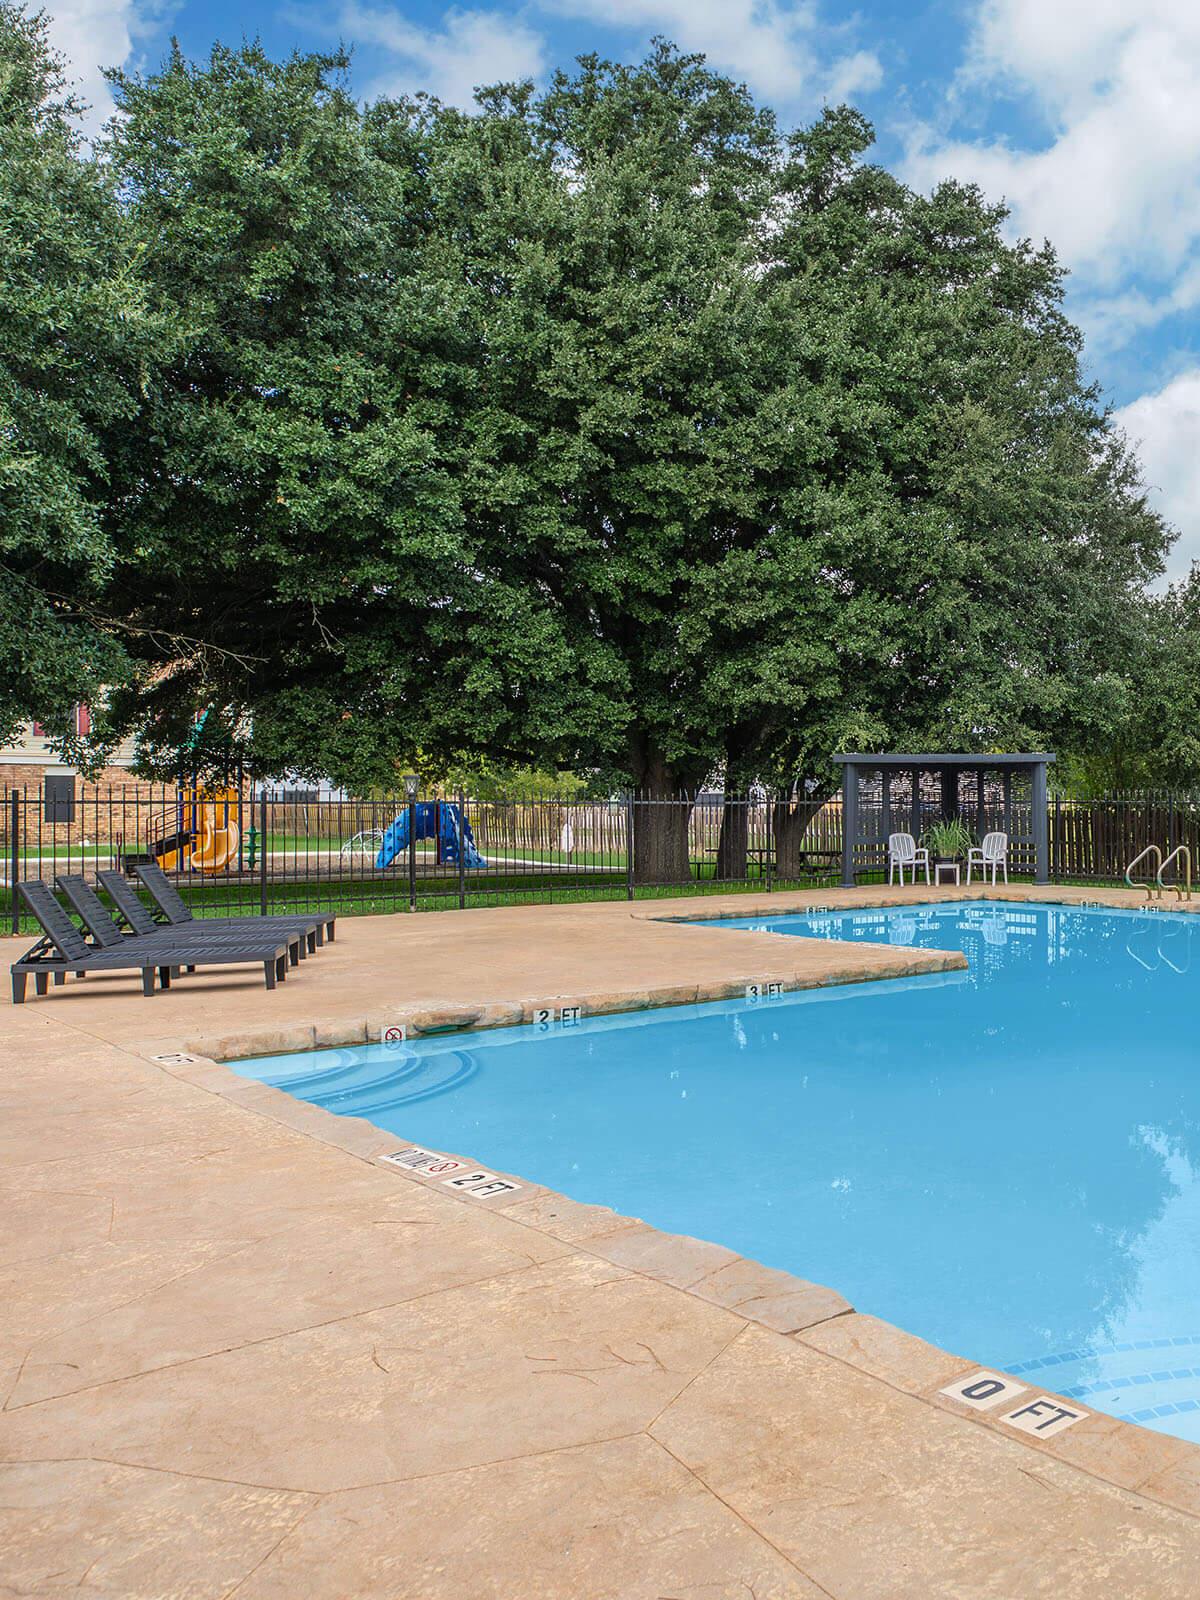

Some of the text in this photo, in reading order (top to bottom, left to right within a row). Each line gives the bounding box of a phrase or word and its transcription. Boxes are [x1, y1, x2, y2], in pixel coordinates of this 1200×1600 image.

[452, 1174, 515, 1196] 2 FT
[961, 1379, 1079, 1431] 0 FT
